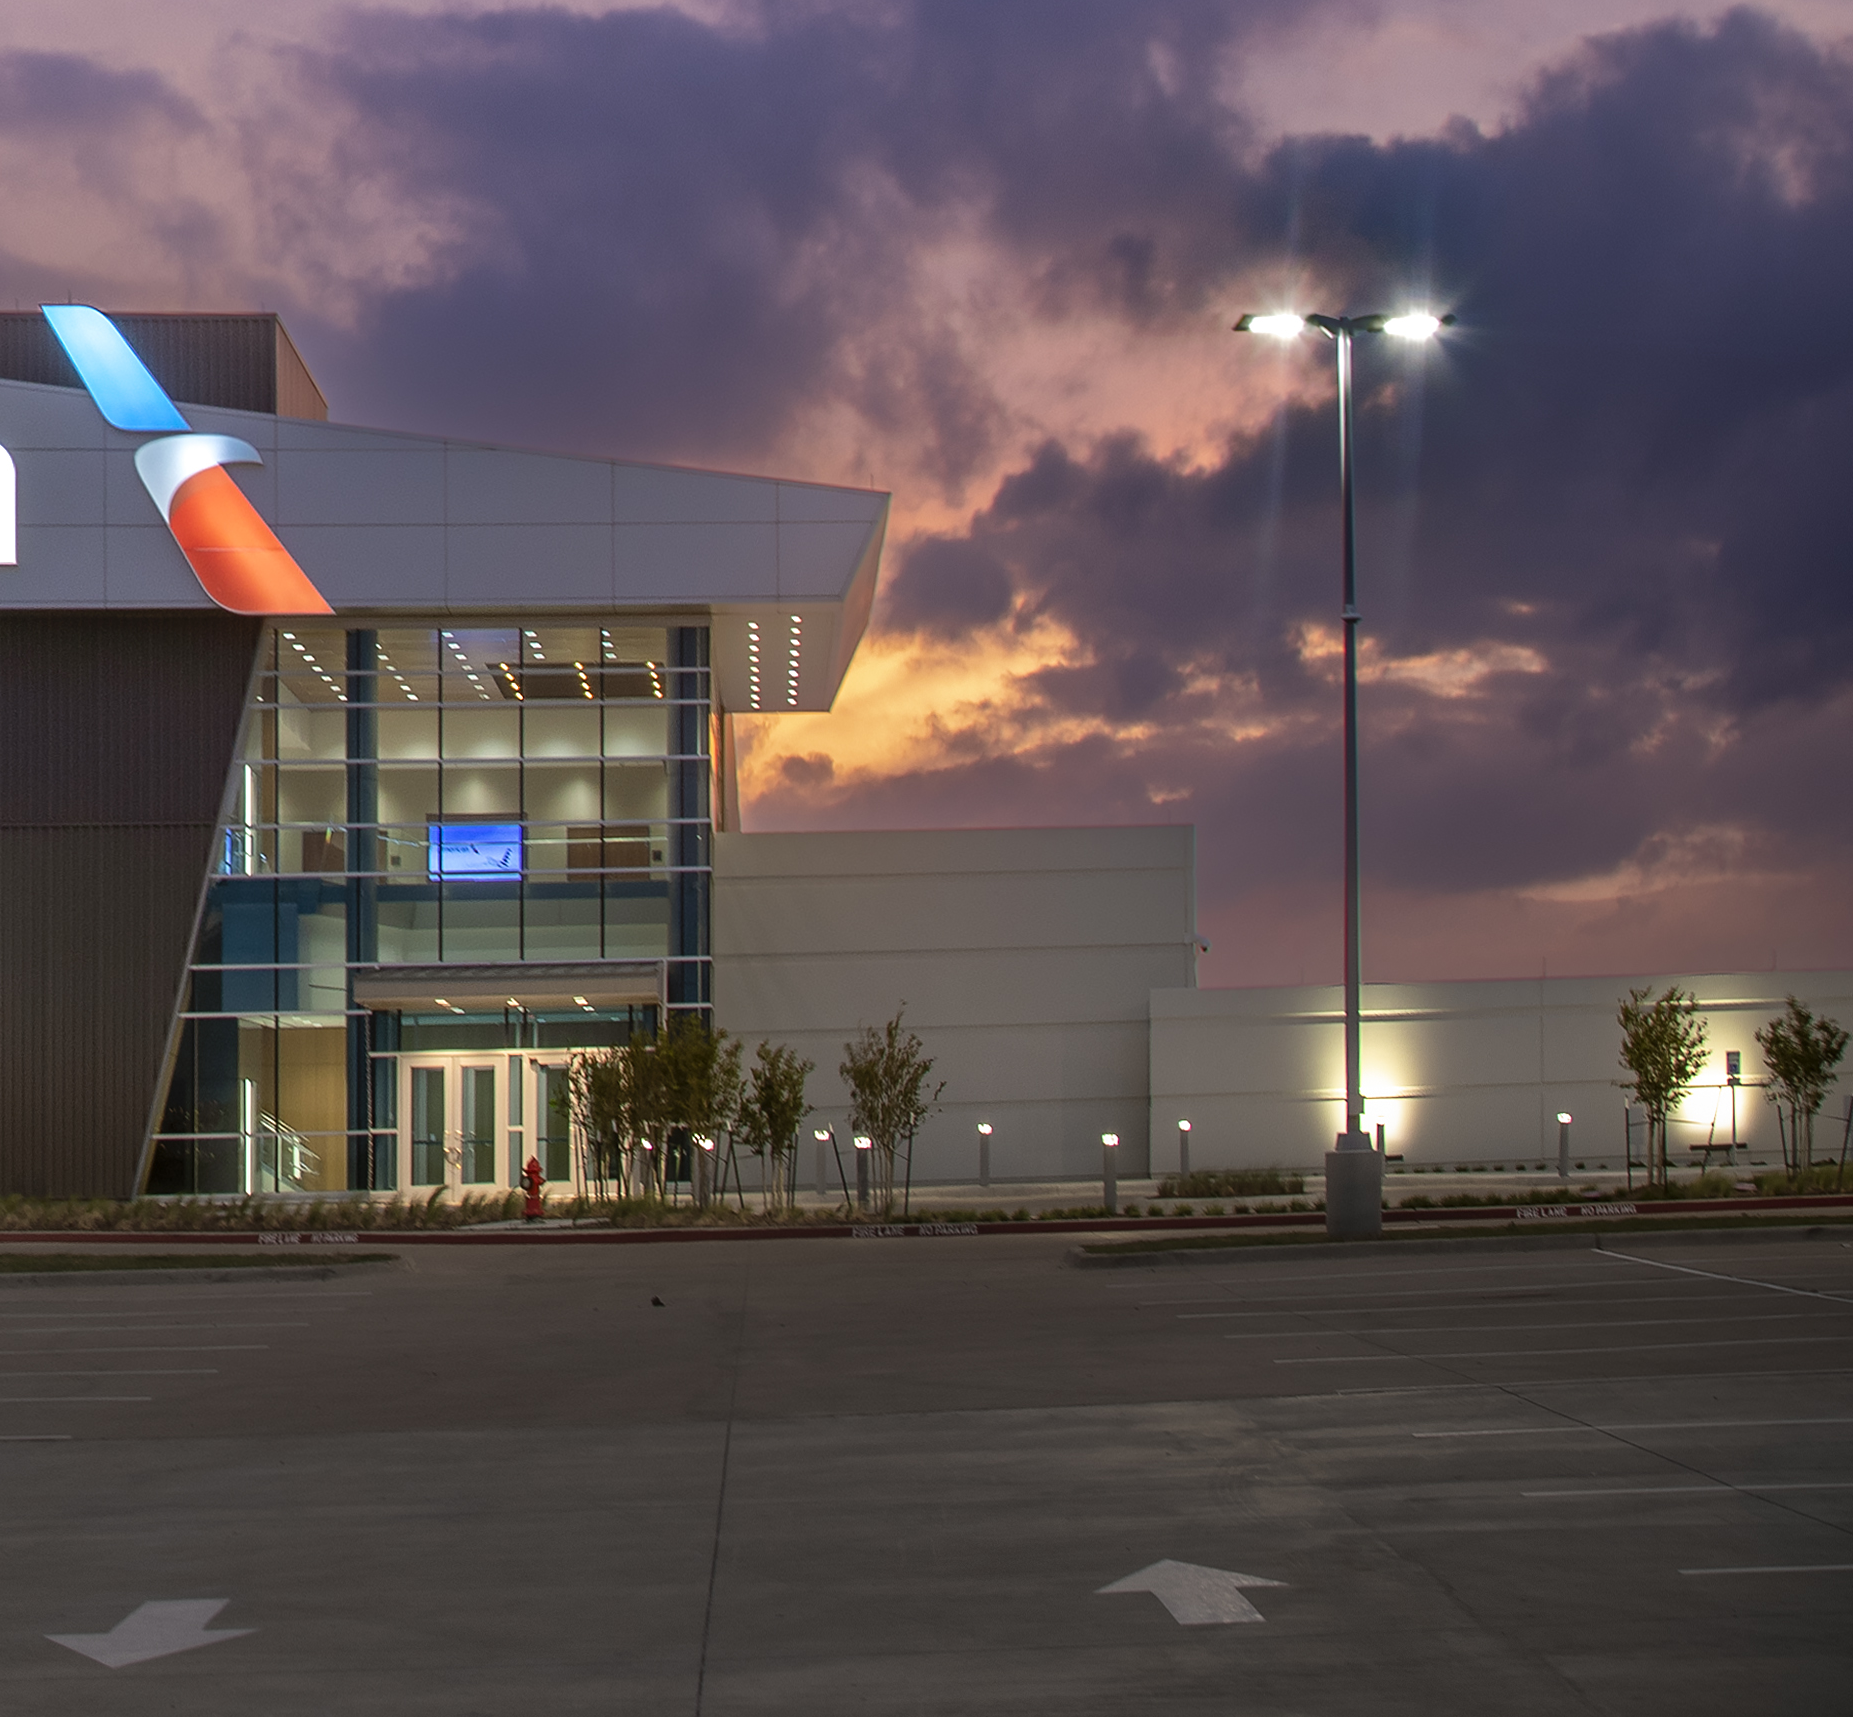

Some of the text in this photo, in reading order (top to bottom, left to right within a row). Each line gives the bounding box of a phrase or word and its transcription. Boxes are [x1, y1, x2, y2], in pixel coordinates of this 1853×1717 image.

[1516, 1203, 1637, 1218] FIRE LANE NO PARKING
